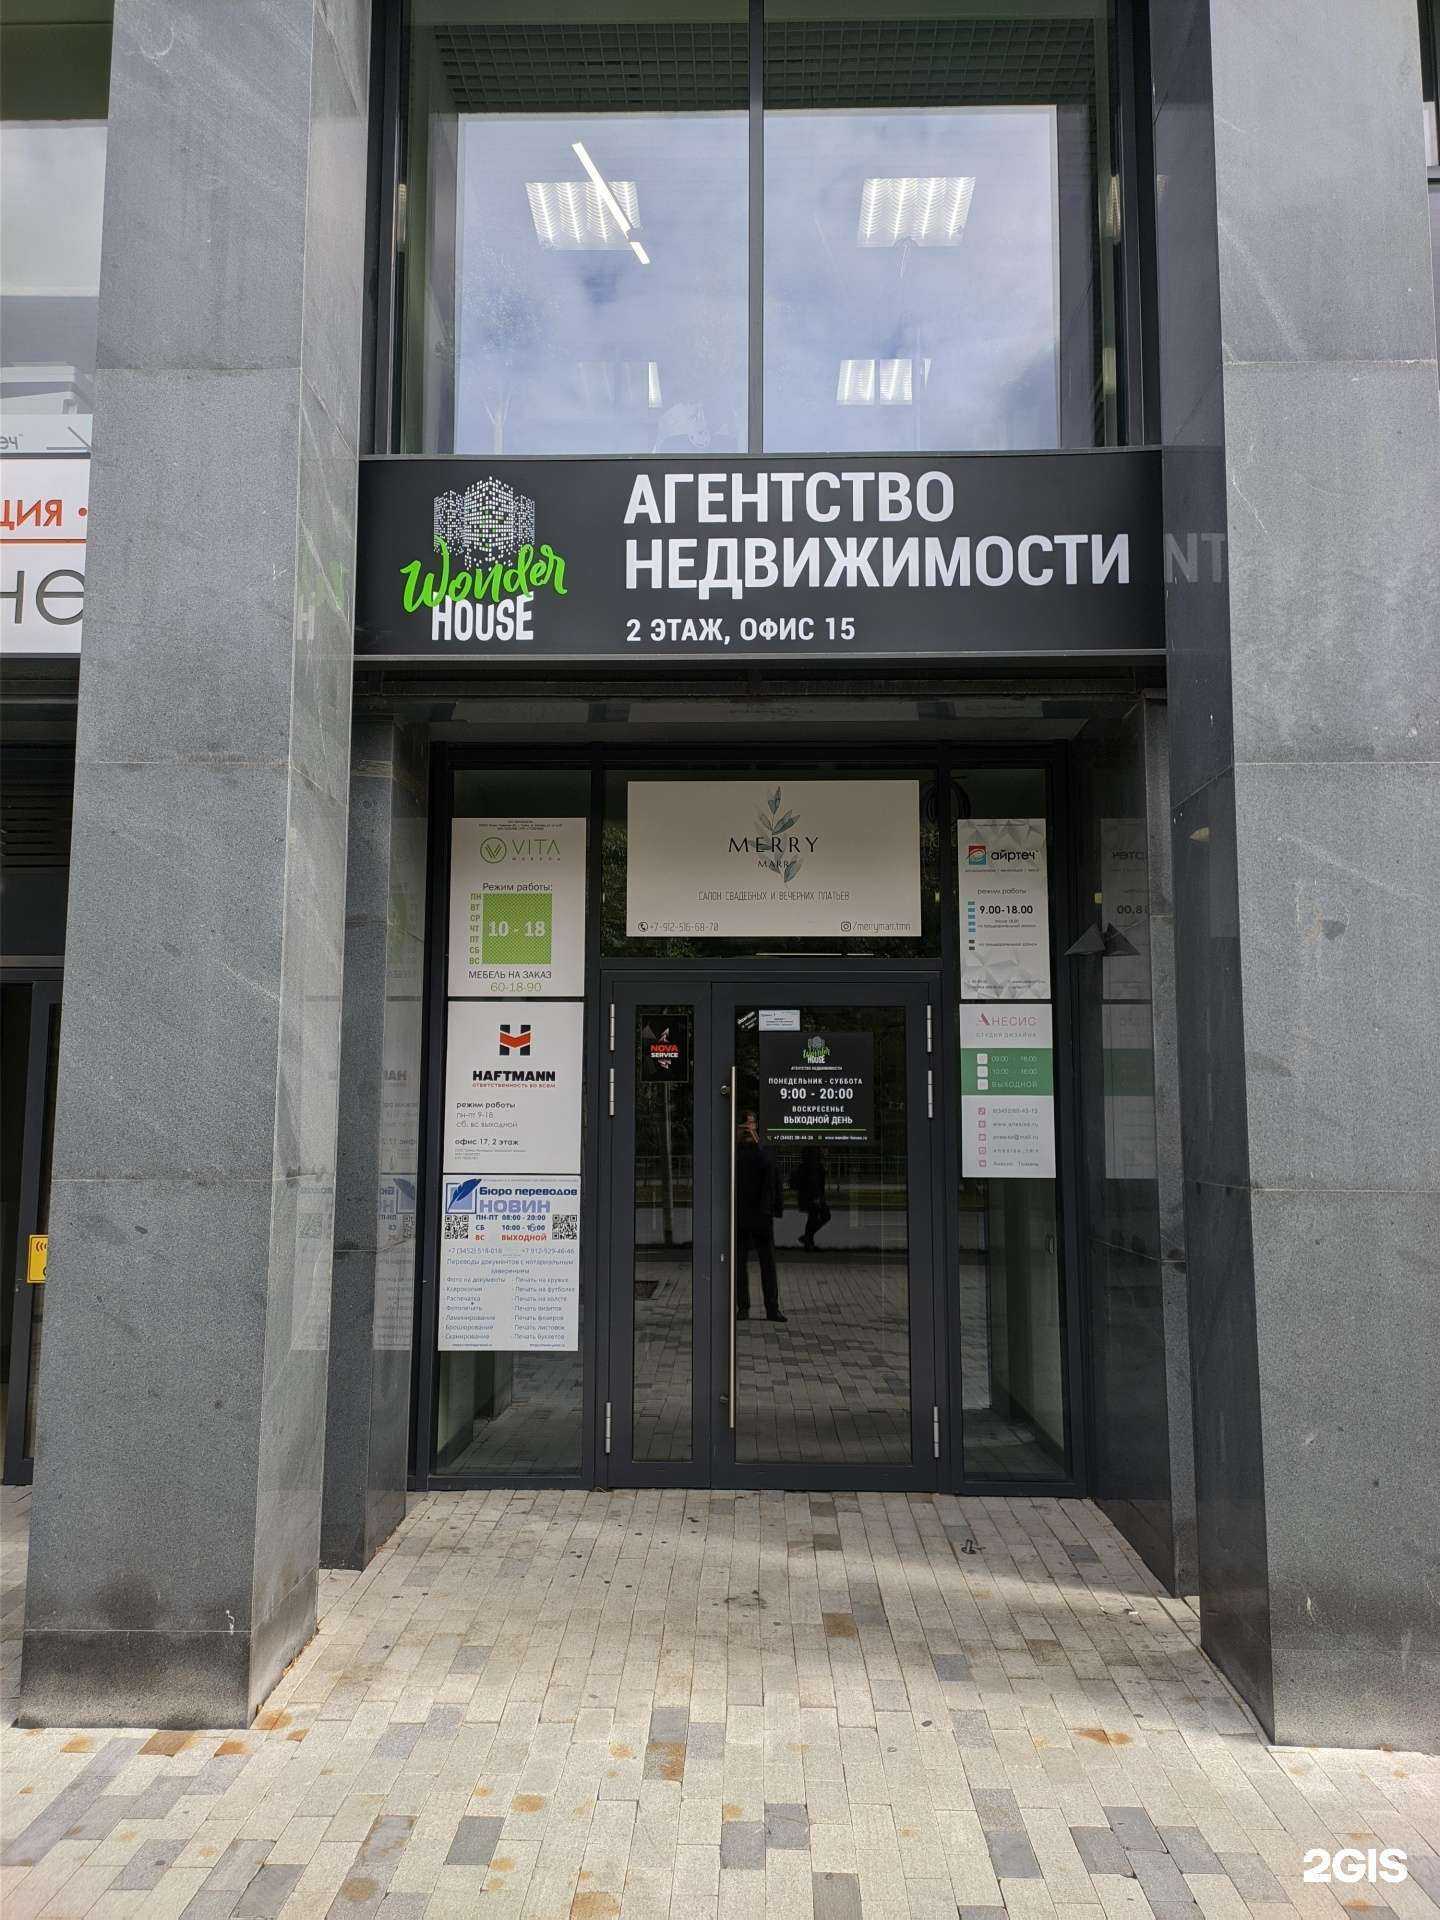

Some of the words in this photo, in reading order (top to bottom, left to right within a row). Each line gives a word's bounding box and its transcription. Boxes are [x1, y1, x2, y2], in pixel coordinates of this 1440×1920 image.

[623, 471, 955, 525] АГЕНТСТВО
[400, 534, 568, 612] Wonder
[625, 533, 1131, 601] НЕДВИЖИМОСТИ
[431, 591, 534, 642] HOUSE
[626, 619, 641, 641] 2
[650, 618, 730, 645] ЭТАЖ,
[740, 617, 815, 641] ОФИС
[825, 617, 856, 640] 15
[512, 839, 561, 855] VITA
[728, 836, 819, 853] MERRY
[990, 849, 1036, 861] айртеч
[482, 883, 515, 892] Режим
[516, 882, 553, 893] работы:
[698, 891, 722, 901] САЛОН
[725, 891, 767, 901] СВАДЕБНЫХ
[770, 891, 776, 901] И
[778, 891, 816, 901] ВЕЧЕРНИХ
[818, 891, 850, 901] ПЛАТЬЕВ
[979, 905, 1034, 914] 9.00-18.00
[488, 921, 509, 937] 10
[524, 921, 545, 937] 18
[468, 971, 506, 979] МЕБЕЛЬ
[508, 971, 521, 979] НА
[522, 971, 552, 979] ЗАКАЗ
[490, 982, 542, 992] 60-18-90
[651, 1044, 678, 1052] NOVA
[472, 1070, 556, 1082] HAFTMANN
[768, 1077, 823, 1086] ПОНЕДЕЛЬНИК
[829, 1077, 863, 1085] СУББОТА
[780, 1088, 807, 1100] 9:00
[819, 1088, 853, 1100] 20:00
[485, 1101, 516, 1109] работы
[792, 1105, 845, 1113] ВОСКРЕСЕНЬЕ
[783, 1114, 830, 1126] ВЫХОДНОЙ
[831, 1115, 853, 1126] ДЕНЬ
[455, 1138, 477, 1147] офис
[492, 1138, 497, 1146] 2
[479, 1187, 512, 1197] Бюро
[514, 1187, 578, 1197] переводов
[479, 1200, 550, 1213] НОВИН
[501, 1233, 547, 1242] ВЫХОДНОЙ
